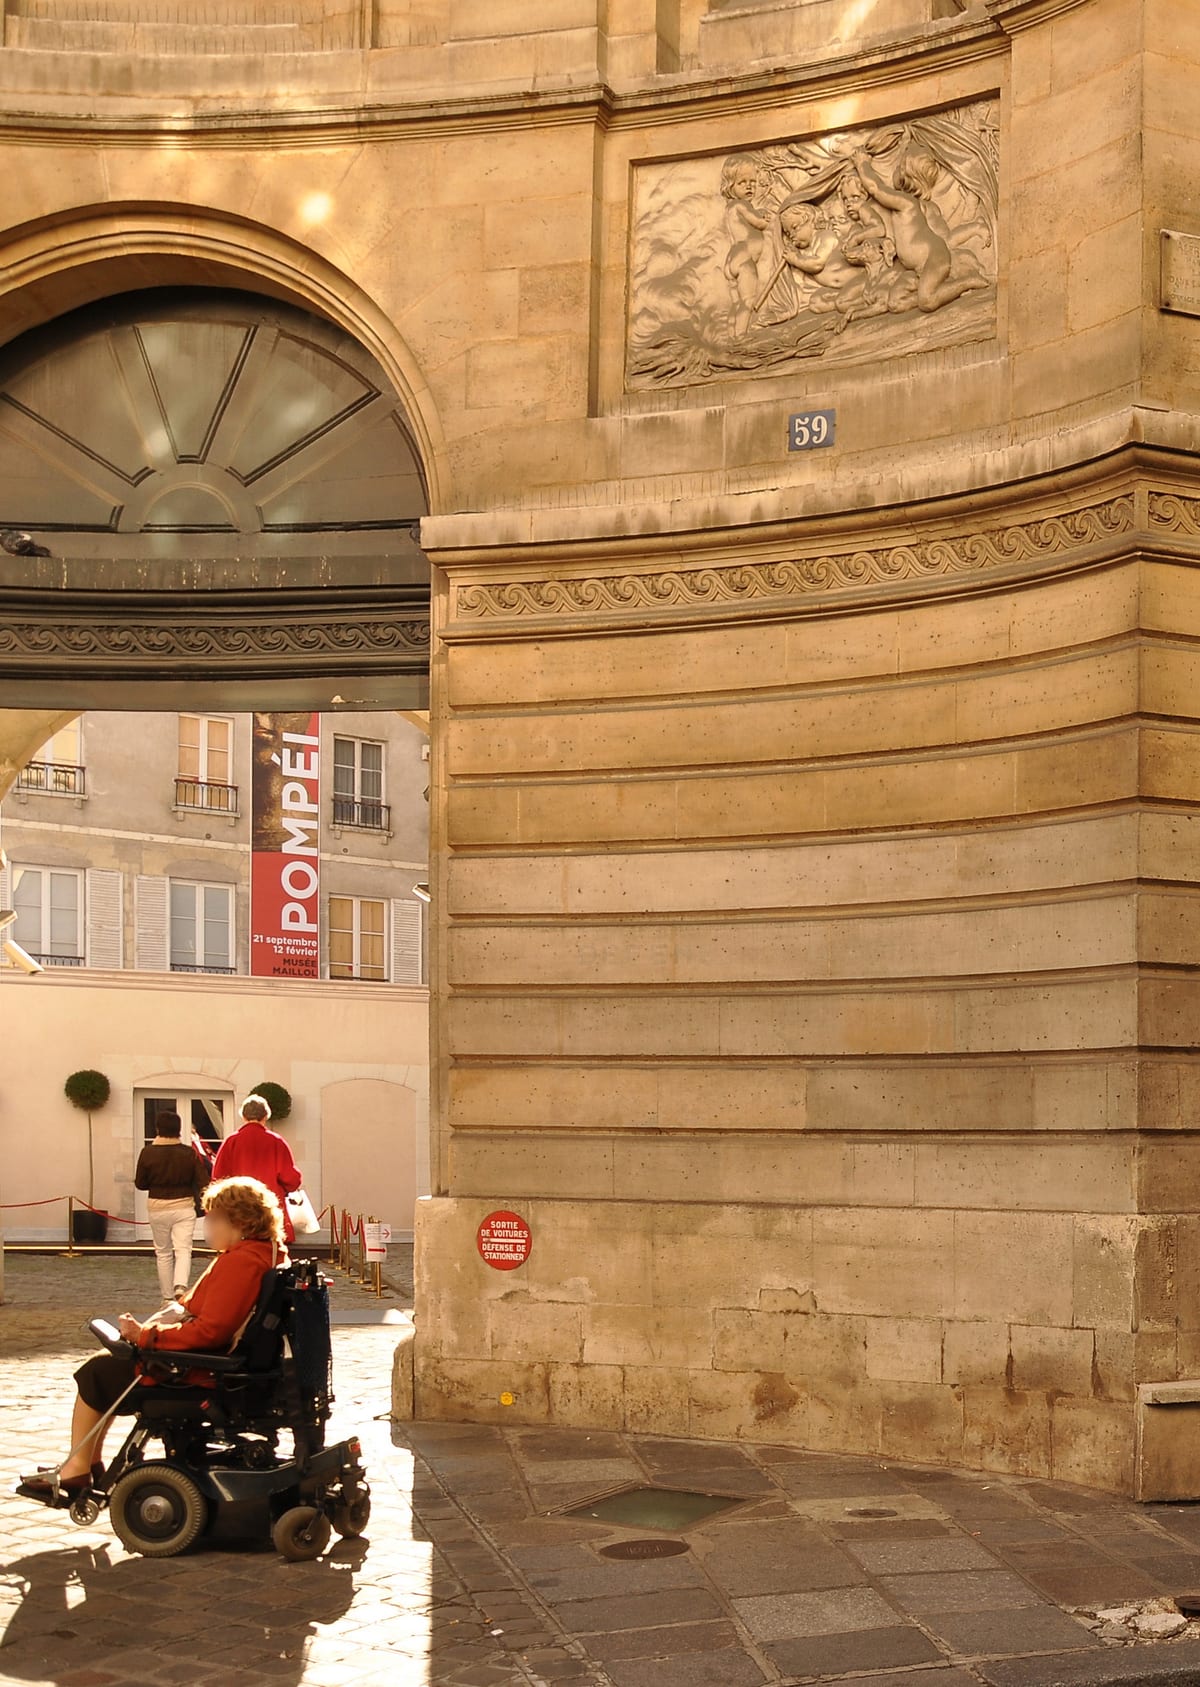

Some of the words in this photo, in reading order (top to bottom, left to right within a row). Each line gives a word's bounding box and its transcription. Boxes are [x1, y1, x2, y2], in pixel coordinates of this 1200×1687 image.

[795, 415, 828, 446] 59
[271, 732, 319, 932] POMPÉI
[253, 934, 264, 943] 21
[265, 935, 318, 947] septembre
[273, 945, 284, 954] 12
[286, 945, 318, 956] février
[283, 958, 318, 968] MUSÉE
[272, 967, 318, 977] MAILLOL
[490, 1220, 519, 1229] SORTIE
[481, 1229, 491, 1237] DE
[493, 1229, 529, 1238] VOITURES
[482, 1243, 515, 1252] DEFENSE
[516, 1244, 527, 1252] DE
[484, 1252, 525, 1261] STATIONNER
